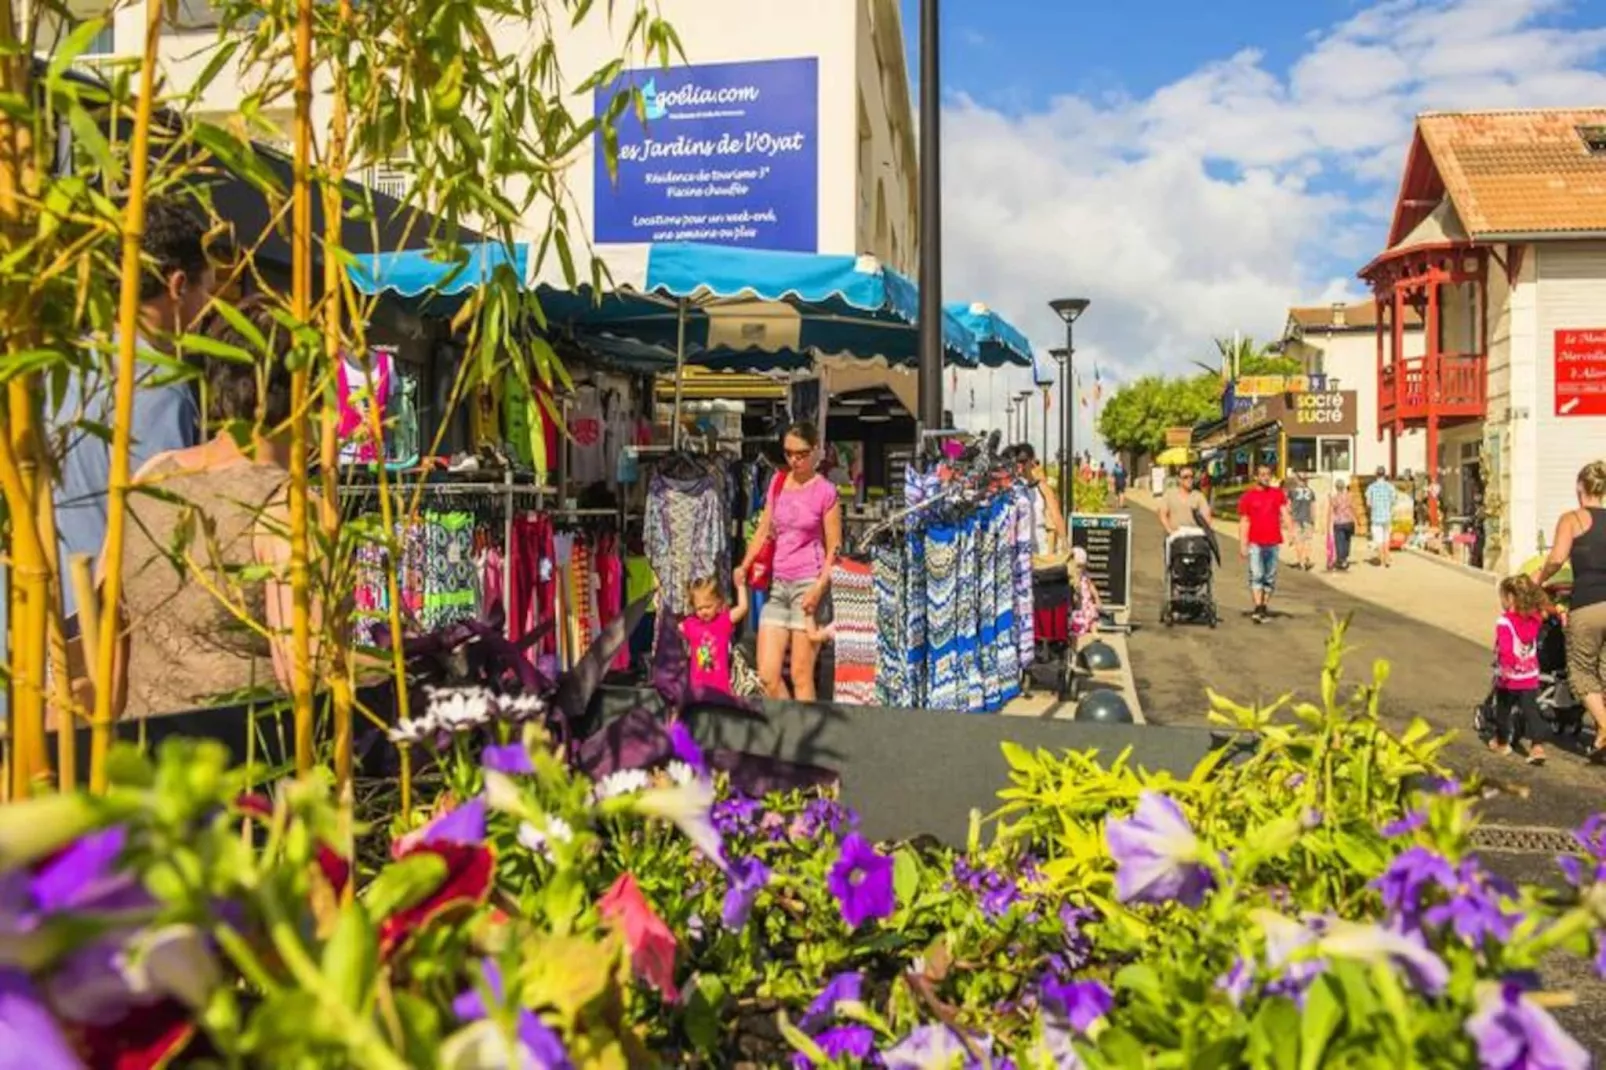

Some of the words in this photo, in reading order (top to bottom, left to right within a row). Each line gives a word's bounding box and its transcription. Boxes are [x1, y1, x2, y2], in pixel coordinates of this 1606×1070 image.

[638, 135, 716, 161] Jardins
[717, 133, 743, 154] de
[632, 214, 681, 227] Locations
[1296, 391, 1344, 408] sacré
[1296, 407, 1343, 424] sucré
